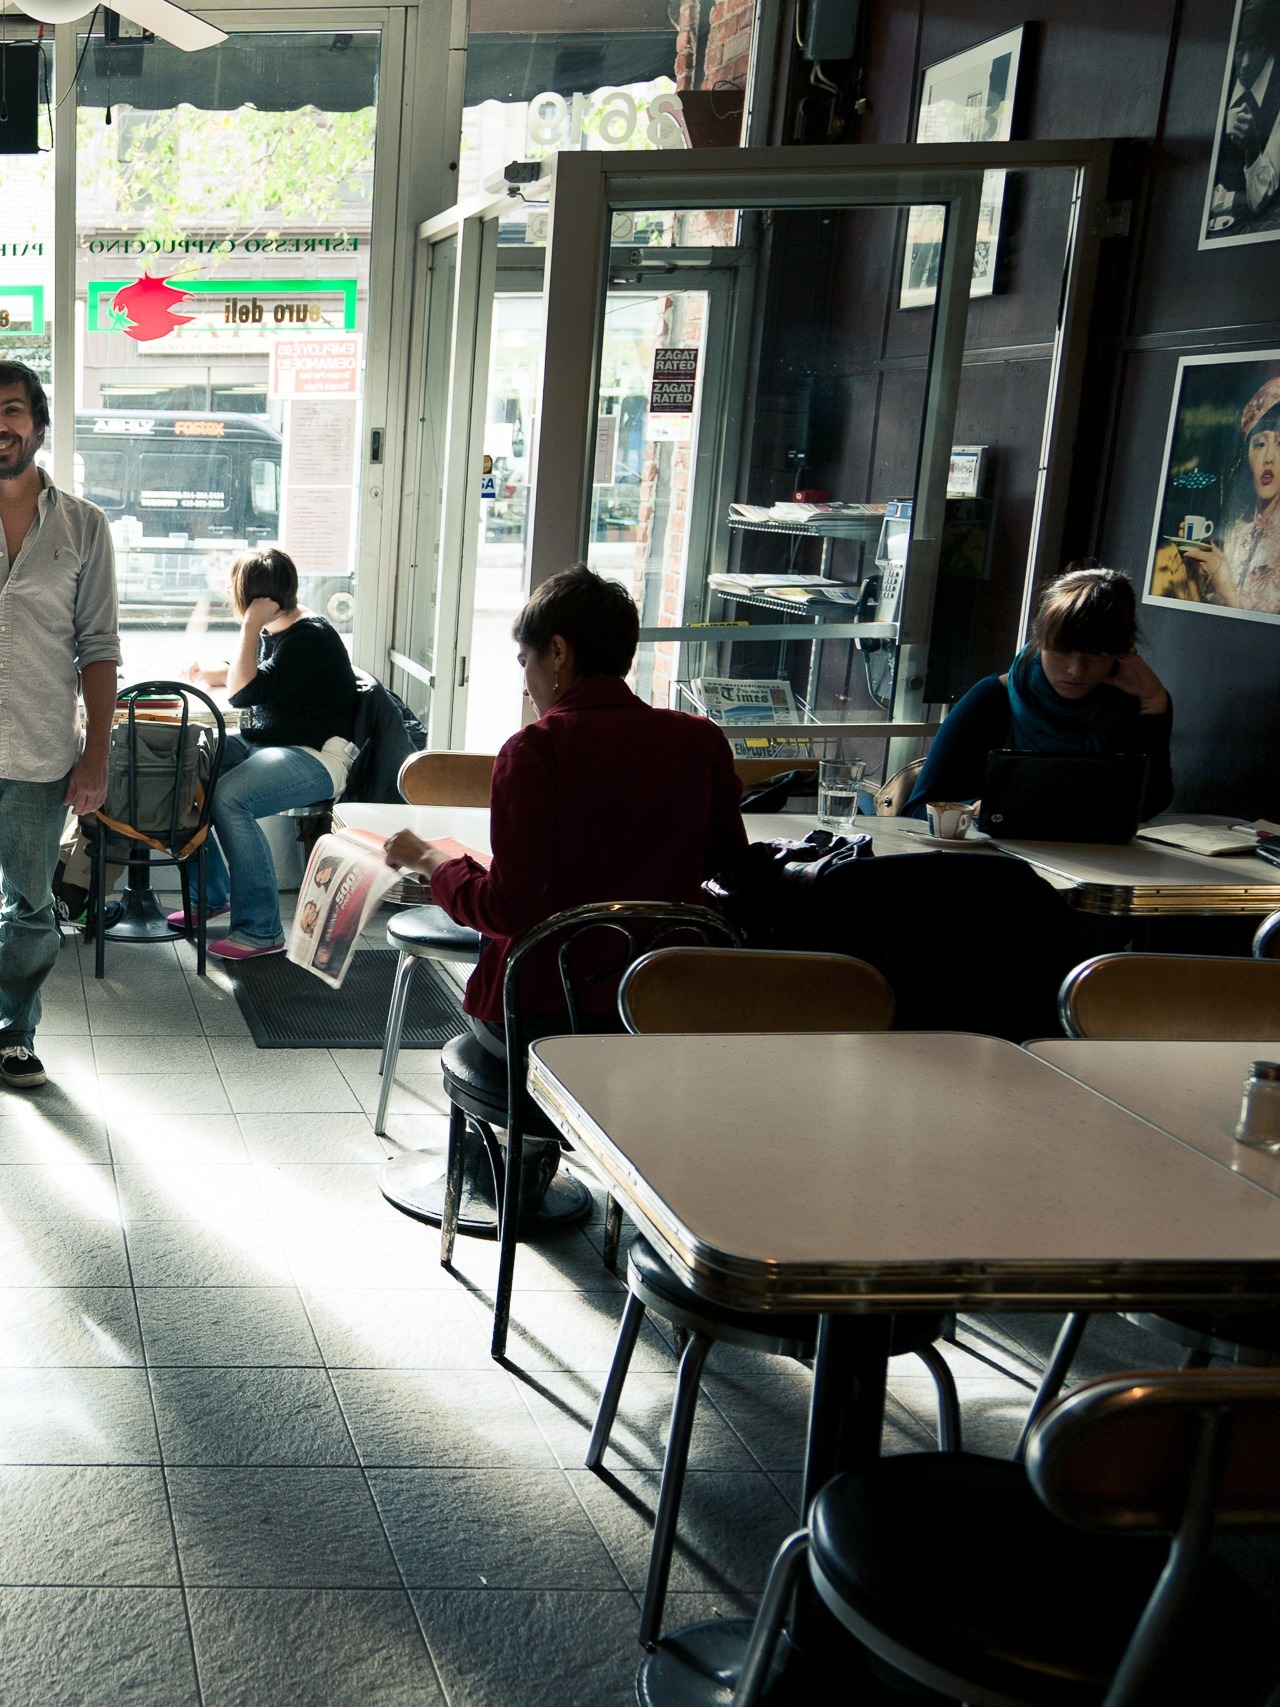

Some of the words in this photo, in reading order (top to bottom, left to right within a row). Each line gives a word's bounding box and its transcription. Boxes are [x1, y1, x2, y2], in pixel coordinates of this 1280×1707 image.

[656, 350, 697, 360] ZAGAT
[655, 360, 696, 370] RATED
[653, 383, 693, 393] ZAGAT
[652, 393, 692, 403] RATED
[721, 687, 769, 704] Times
